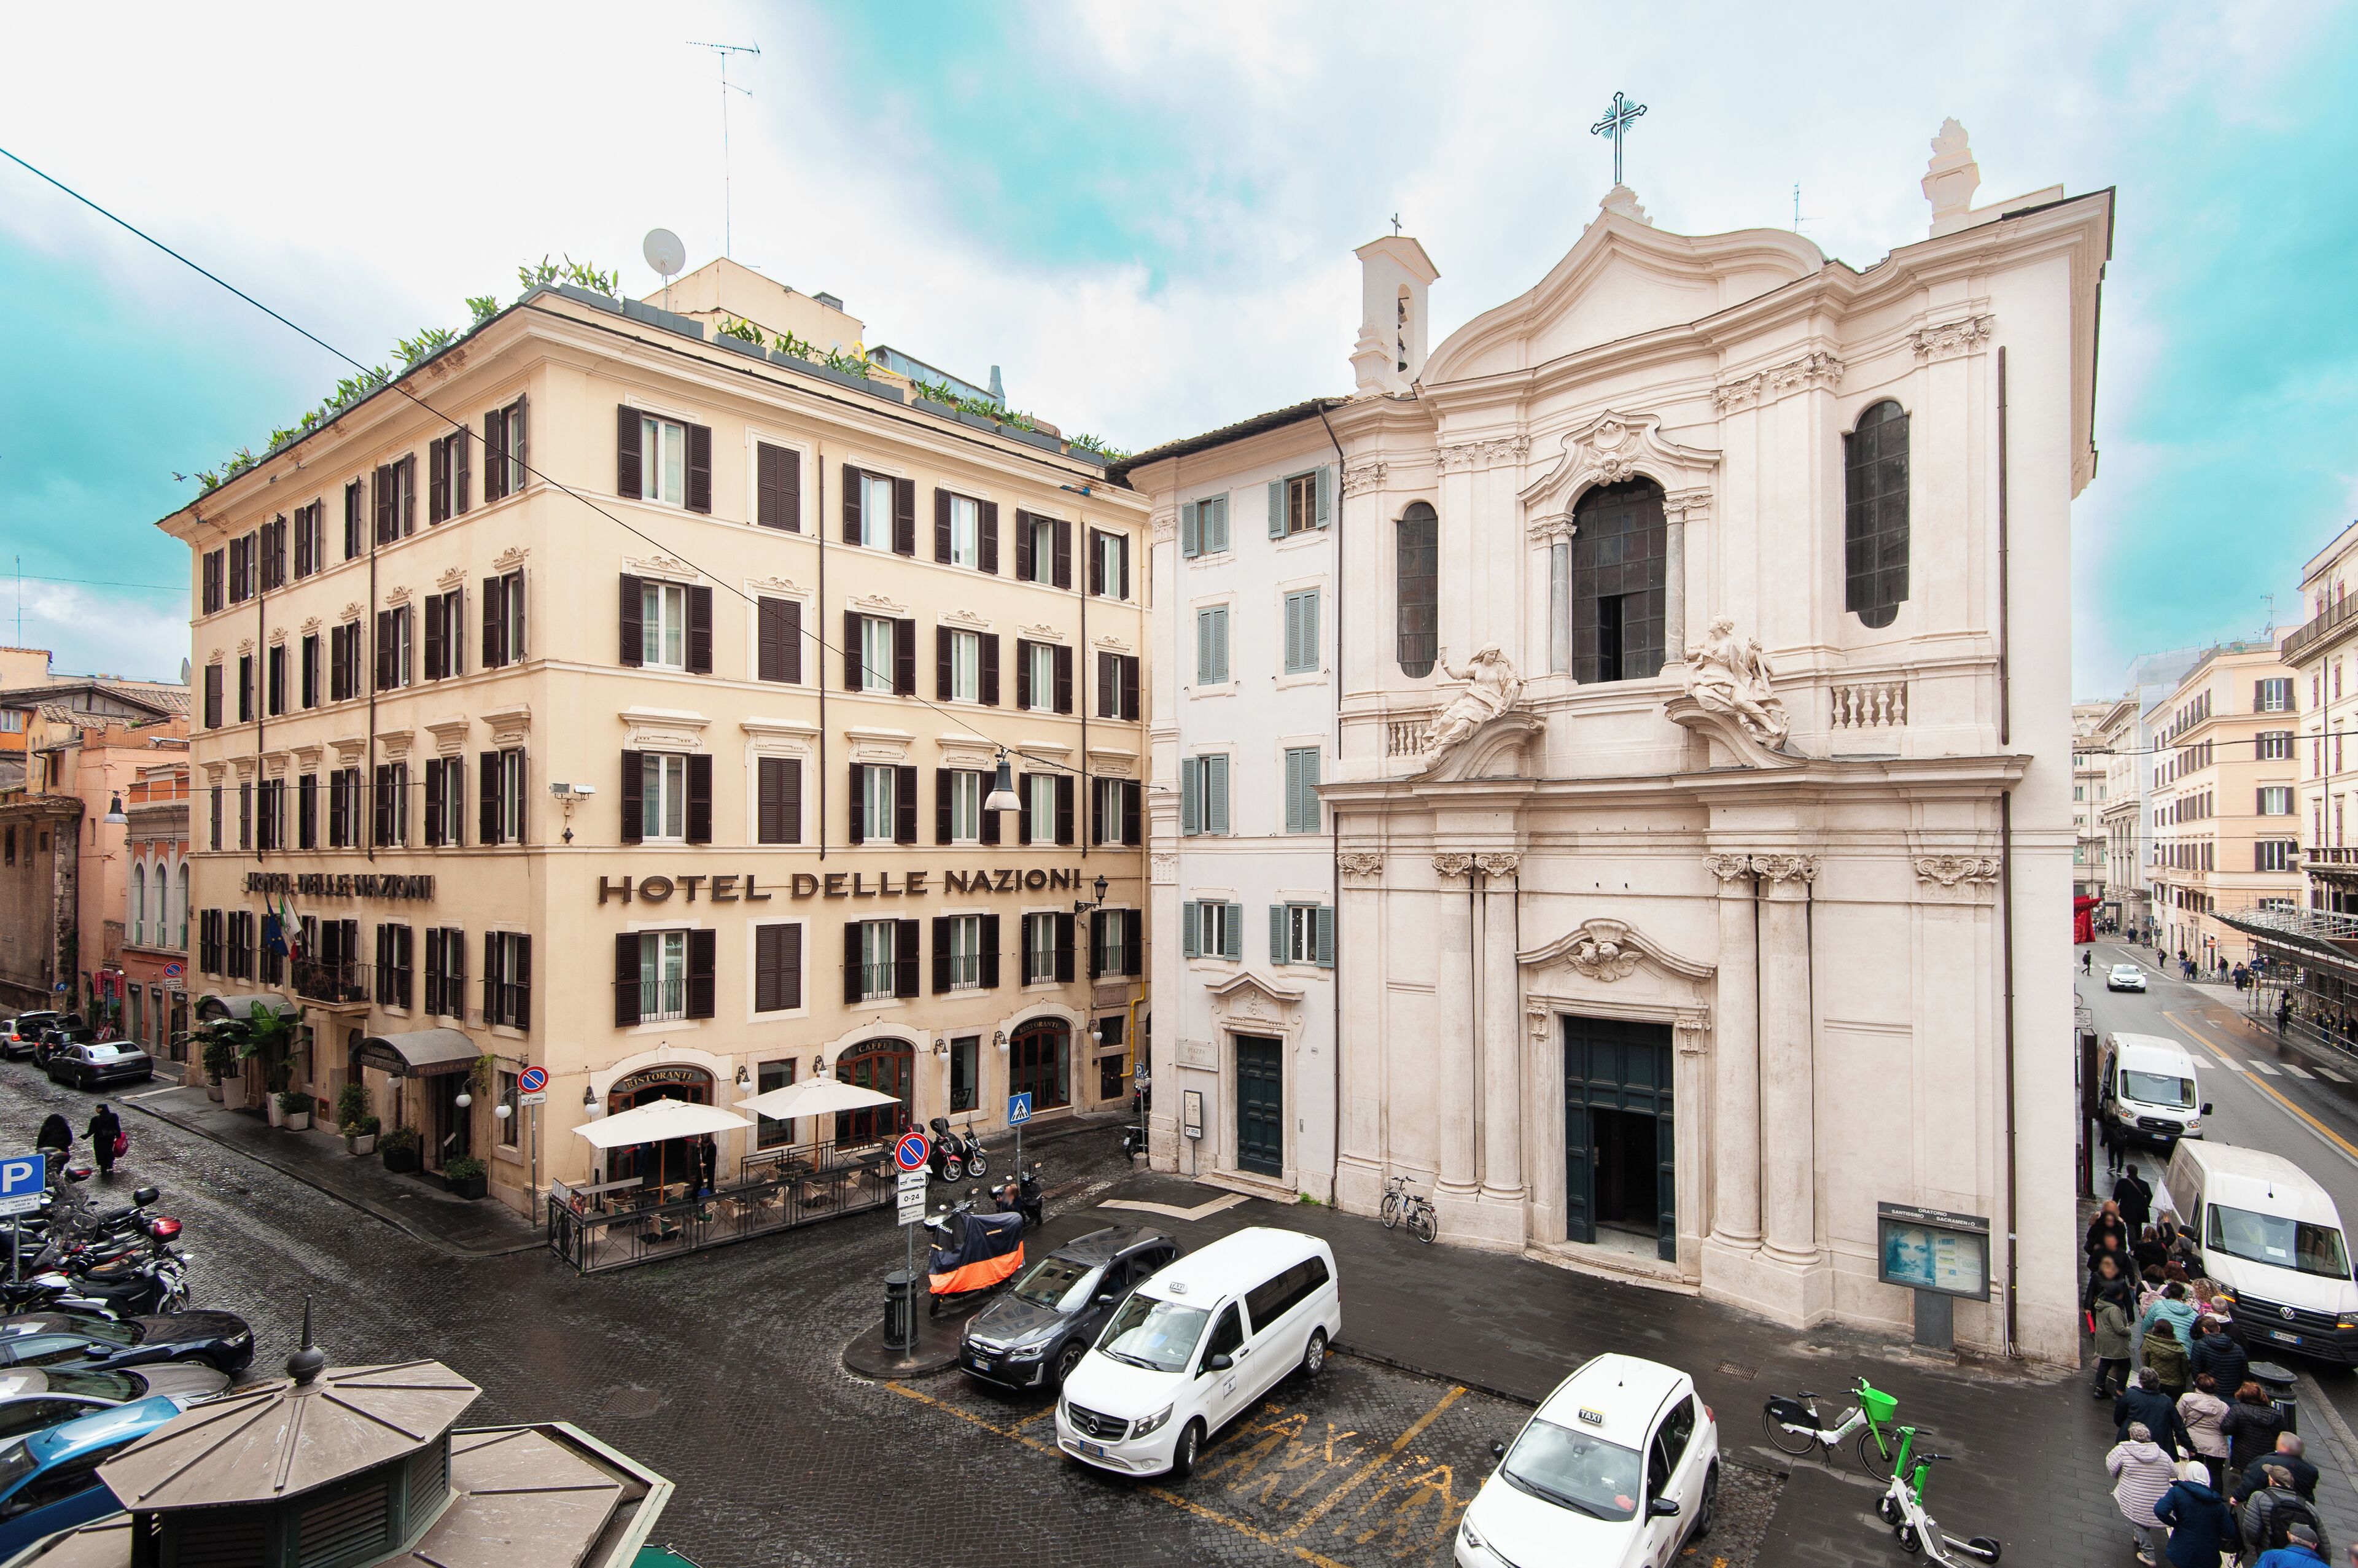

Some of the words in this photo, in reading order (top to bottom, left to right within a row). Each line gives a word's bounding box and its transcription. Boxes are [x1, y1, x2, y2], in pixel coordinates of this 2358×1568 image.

[247, 872, 297, 894] HOTEL
[298, 873, 353, 898] DELLE
[354, 874, 435, 900] NAZIONI
[598, 874, 771, 904] HOTEL
[790, 870, 928, 899] DELLE
[943, 867, 1082, 893] NAZIONI
[1019, 1021, 1060, 1034] RISTORANTE
[418, 1062, 475, 1074] Ristorant
[1136, 1065, 1142, 1077] P
[626, 1071, 695, 1090] RISTORANTE
[2, 1162, 33, 1193] P
[904, 1193, 920, 1202] 0-24
[1891, 1209, 1924, 1219] SANTISSIMO
[1918, 1208, 1947, 1217] ORATORIO
[1170, 1282, 1185, 1291] TAXI
[1580, 1410, 1601, 1422] TAXI
